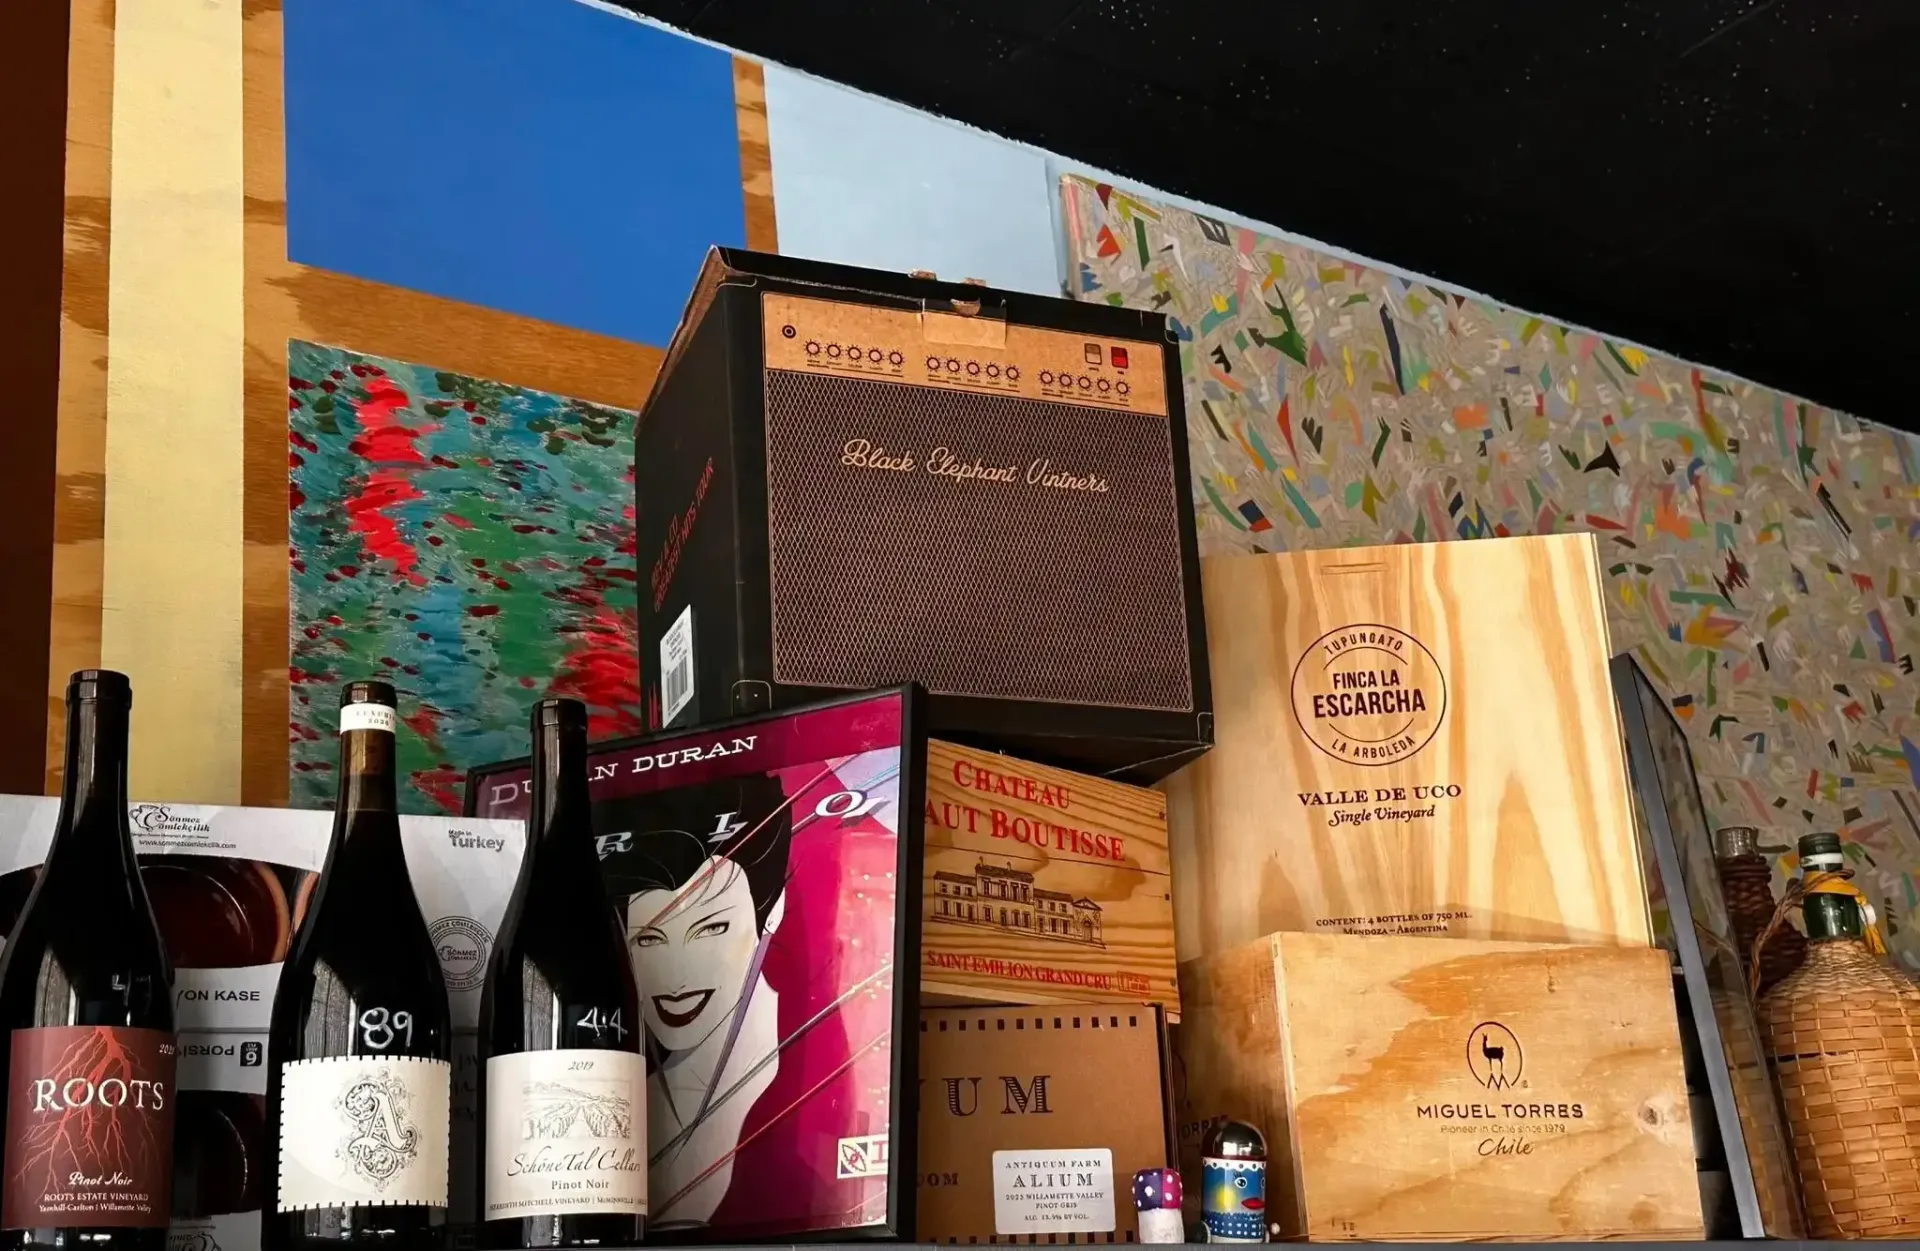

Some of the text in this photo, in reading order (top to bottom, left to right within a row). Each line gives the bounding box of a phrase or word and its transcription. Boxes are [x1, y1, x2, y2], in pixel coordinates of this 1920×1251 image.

[841, 439, 1109, 492] Black Elephant Vintners
[1323, 632, 1403, 655] TUPUNGATO
[1333, 669, 1400, 689] FINCA LA
[1313, 688, 1426, 718] ESCARCHA
[632, 736, 757, 772] DURAN
[1332, 735, 1416, 759] LA ARBOLEDA
[953, 760, 1070, 809] CHATEAU
[1297, 784, 1461, 806] VALLE DE UCO
[1328, 804, 1435, 827] Single Vineyard
[450, 835, 505, 852] Turkey
[990, 808, 1126, 863] BOUTISSE
[1316, 917, 1366, 927] CONTENT:
[1368, 916, 1374, 925] 4
[1377, 914, 1419, 923] BOTTLES
[1422, 913, 1433, 921] OF
[1436, 911, 1453, 922] 750
[1035, 966, 1082, 986] GRAND
[1085, 973, 1112, 990] CRU
[215, 990, 260, 1001] KASE
[359, 1006, 413, 1049] 89
[576, 1006, 628, 1043] 44
[568, 1061, 594, 1071] 2019
[33, 1077, 164, 1112] ROOTS
[919, 1075, 1053, 1116] UM
[1417, 1103, 1583, 1119] MIGUEL TORRES
[1440, 1123, 1566, 1133] Pioneer in Chile since 1979
[1478, 1136, 1534, 1156] Chile
[597, 1147, 640, 1172] Cellars
[1006, 1161, 1066, 1169] ANTIQUUM
[68, 1171, 133, 1186] Pinot Noir
[551, 1179, 609, 1190] Pinot Noir
[1013, 1173, 1093, 1187] ALIUM
[44, 1192, 149, 1202] ROOTS ESTATE VINEYARD
[100, 1202, 136, 1211] Willamette
[555, 1197, 590, 1205] VINEYARD
